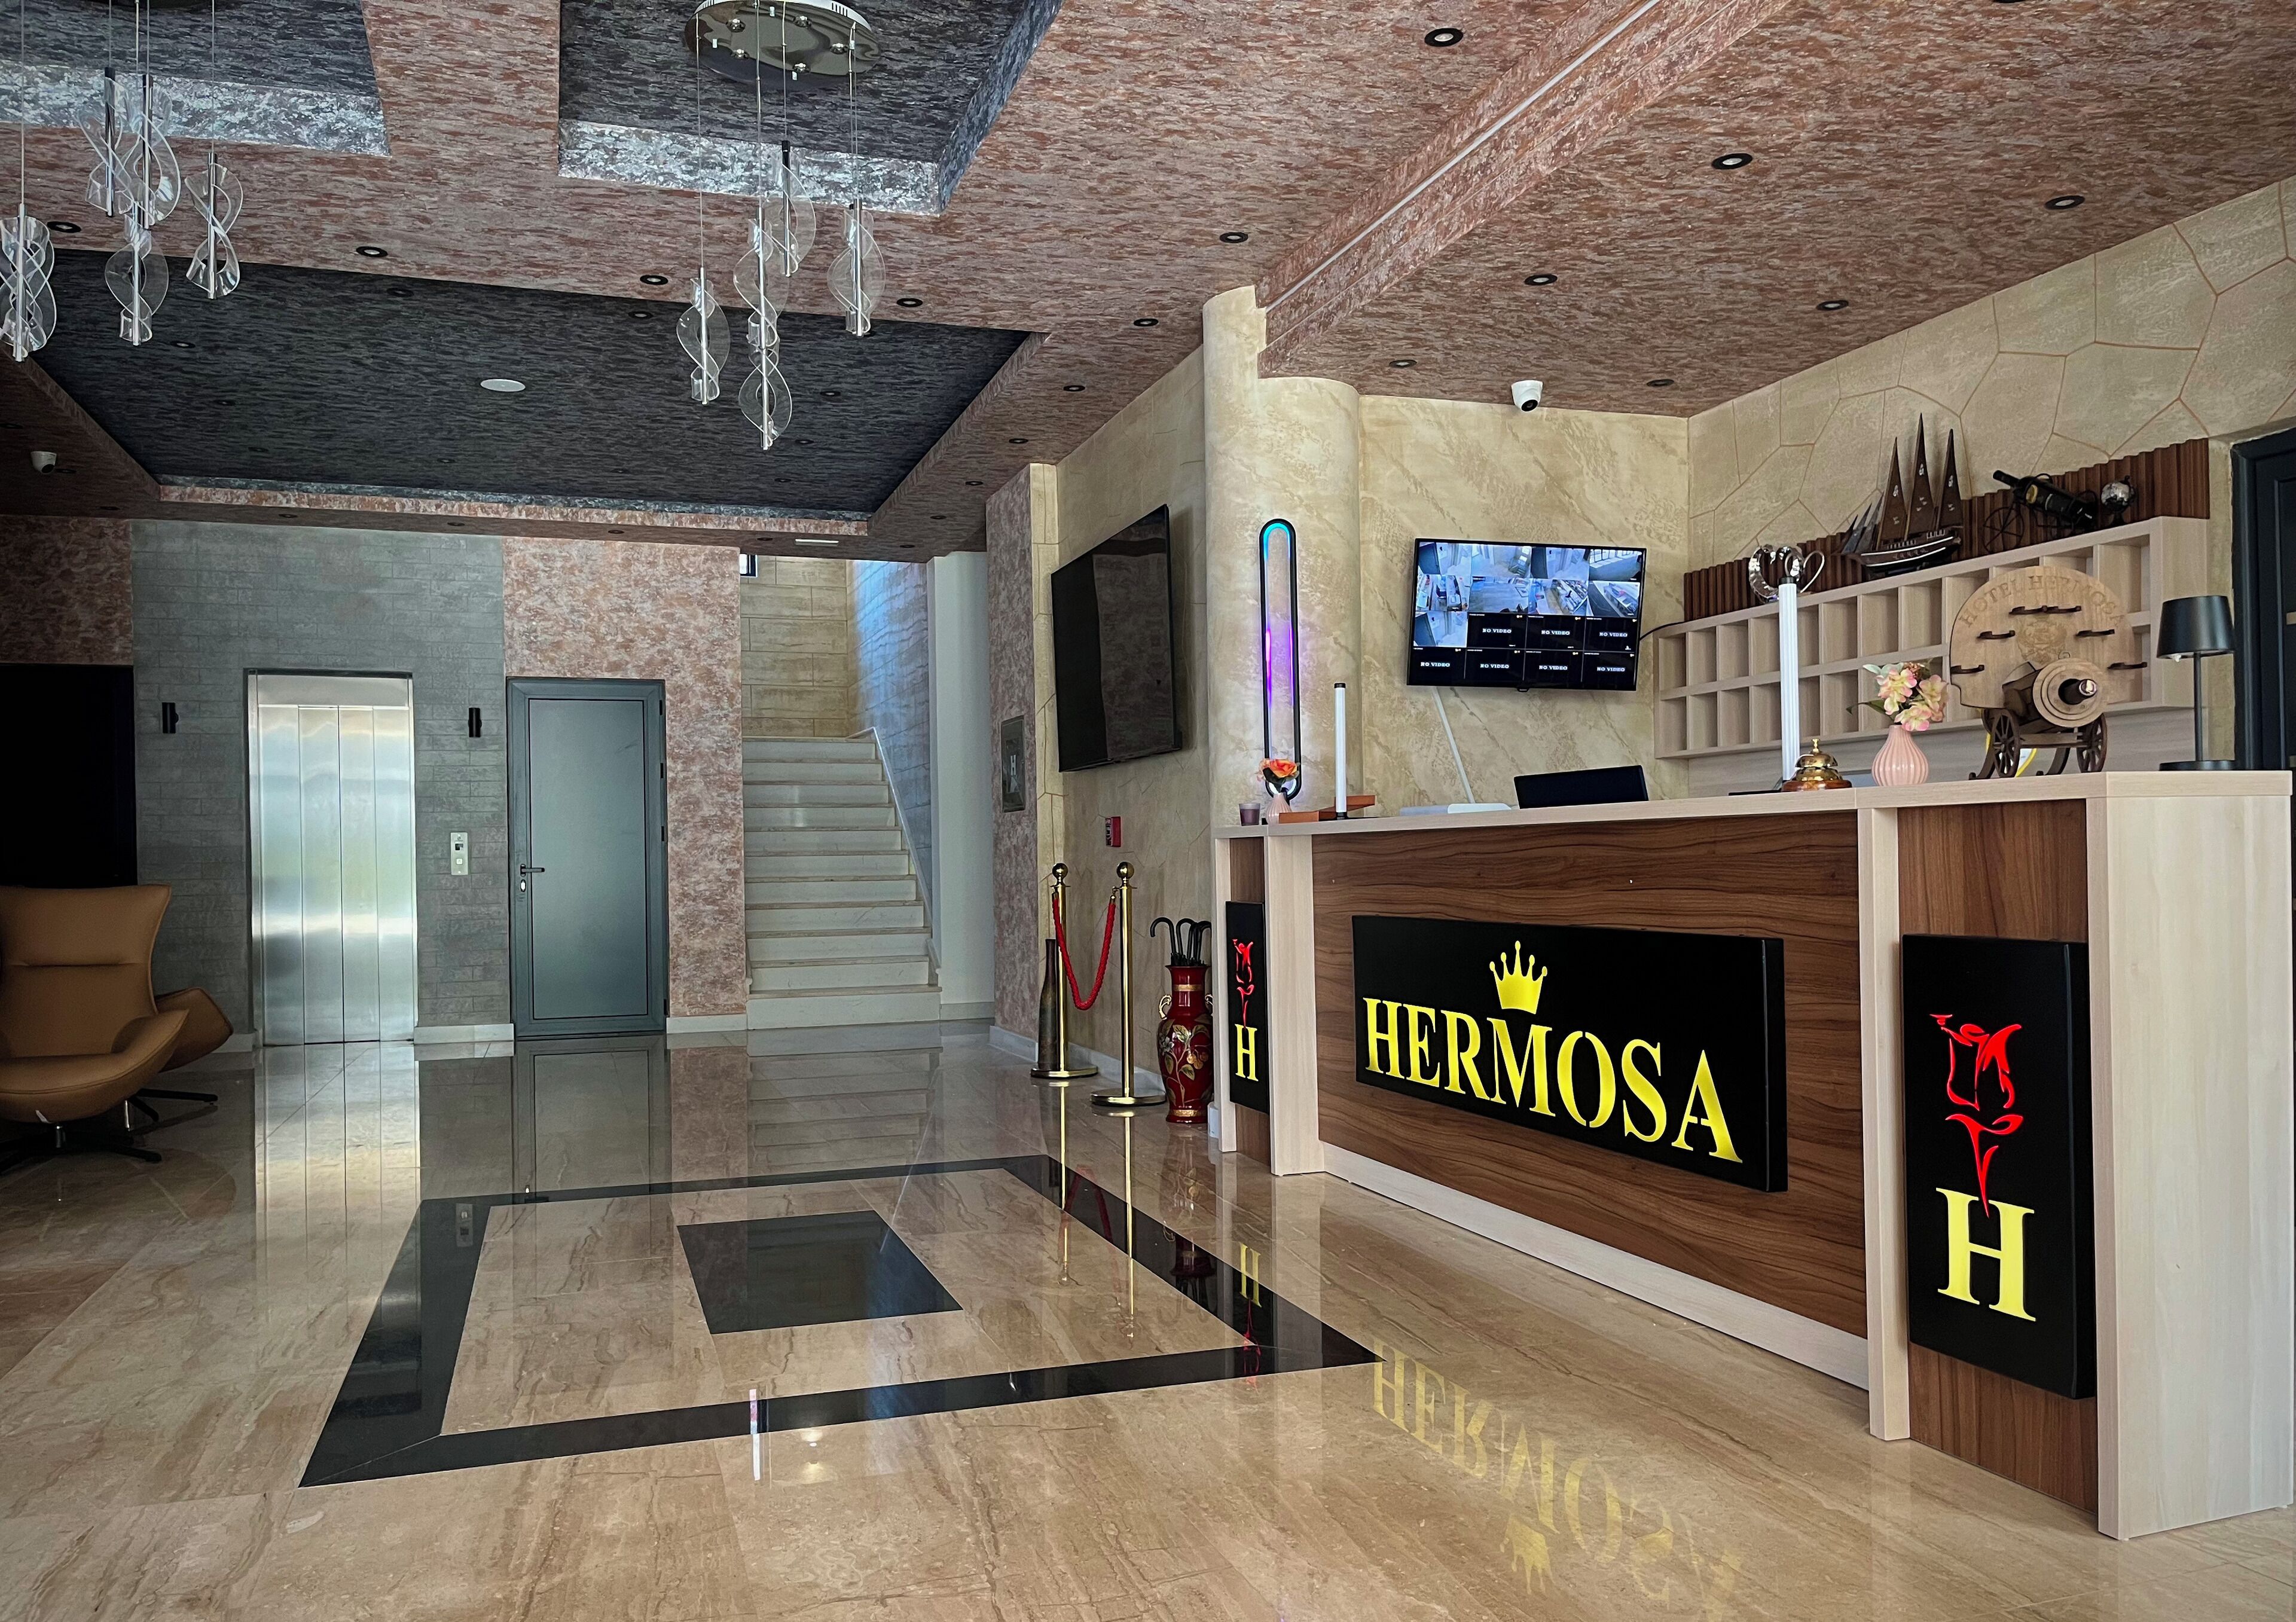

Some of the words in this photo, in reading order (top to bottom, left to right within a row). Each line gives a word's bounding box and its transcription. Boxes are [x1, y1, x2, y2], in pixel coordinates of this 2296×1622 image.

[1958, 578, 2024, 628] HOTEL
[1234, 1024, 1259, 1082] H
[1363, 997, 1743, 1163] HERMOSA
[1935, 1187, 2036, 1322] H
